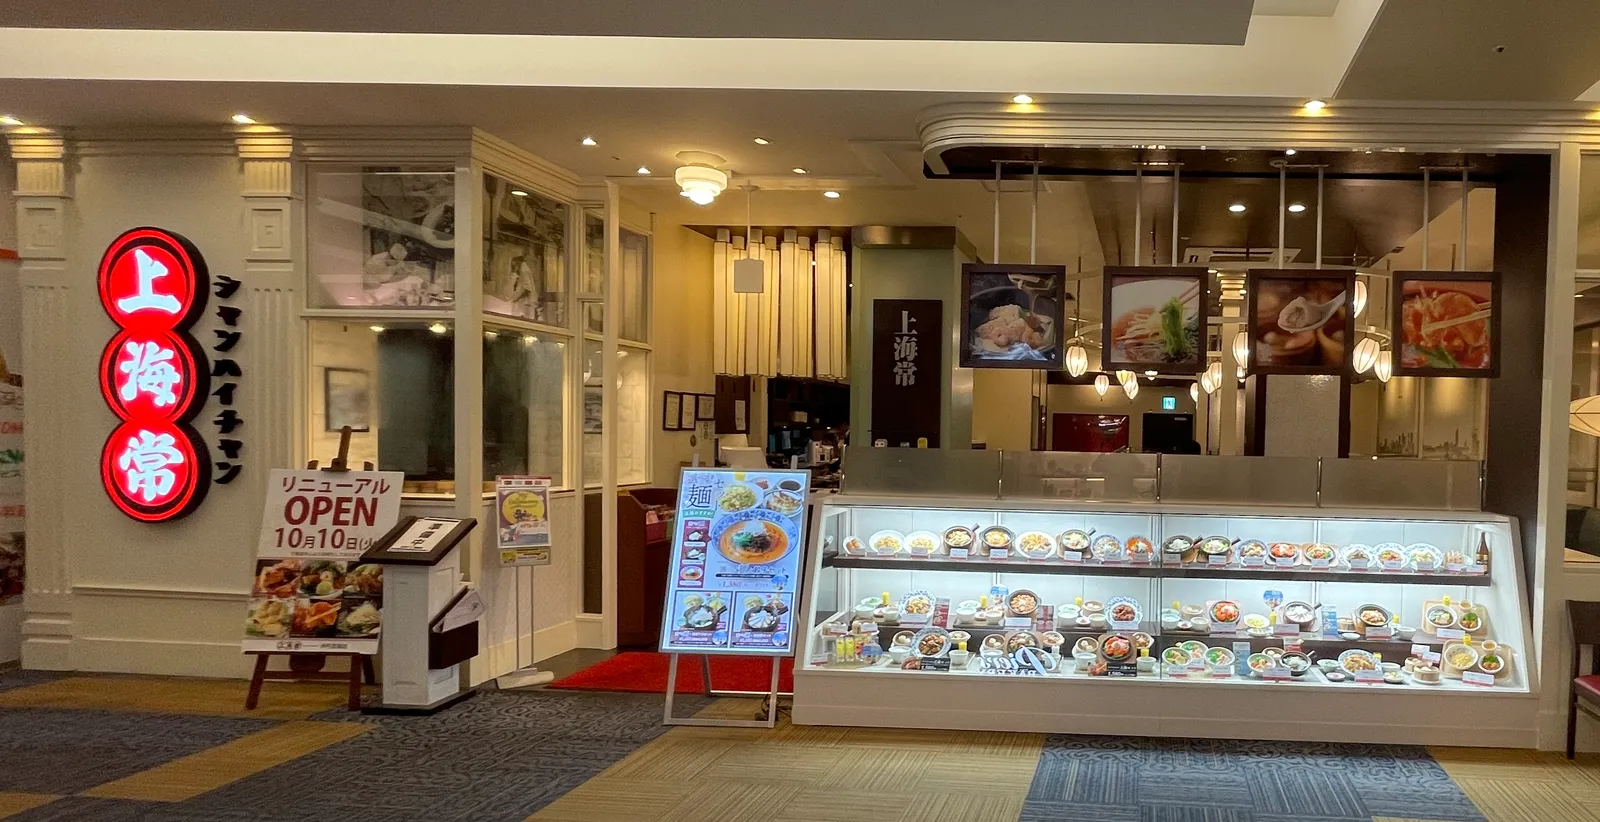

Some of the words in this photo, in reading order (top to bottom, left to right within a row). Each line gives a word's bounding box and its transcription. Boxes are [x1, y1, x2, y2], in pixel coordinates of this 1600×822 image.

[117, 248, 184, 503] 上海常
[892, 310, 919, 387] 上海常
[210, 274, 244, 485] シャンハイチャン
[282, 475, 391, 495] リニューアル
[284, 495, 379, 527] OPEN
[687, 483, 713, 508] 麺
